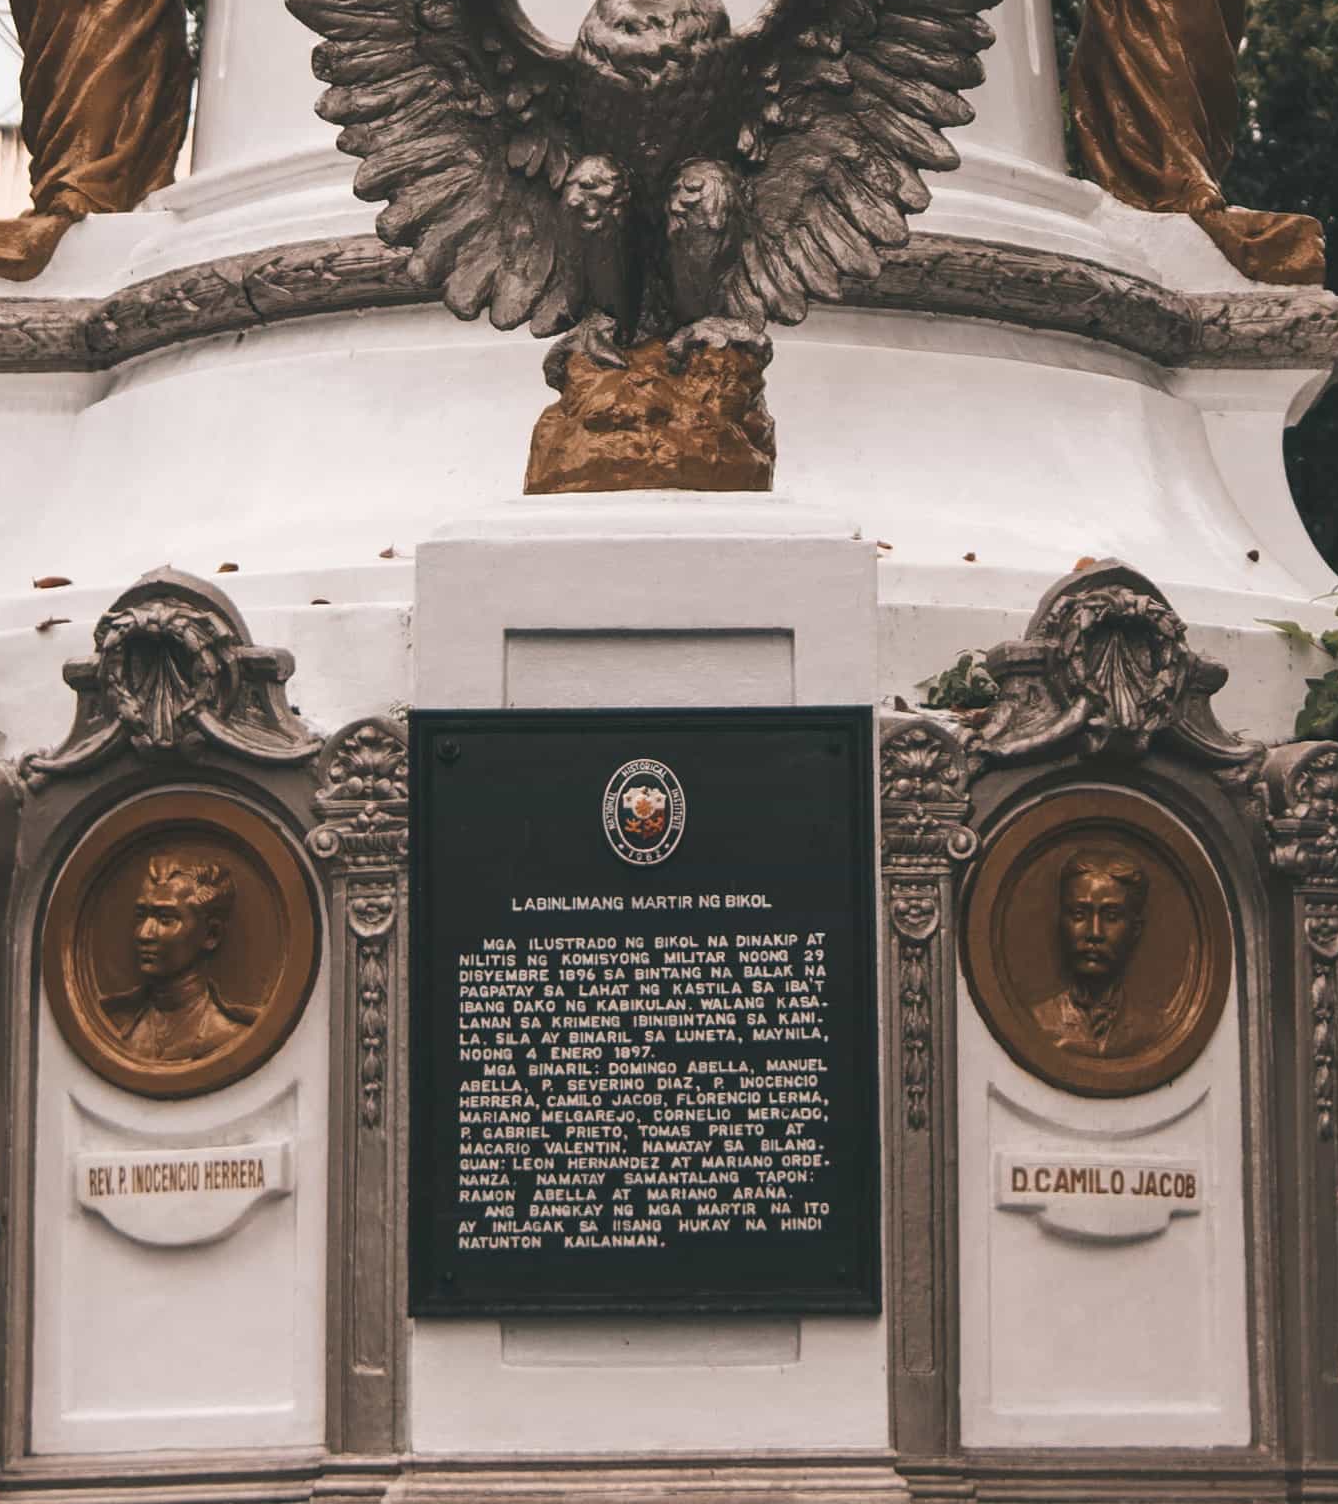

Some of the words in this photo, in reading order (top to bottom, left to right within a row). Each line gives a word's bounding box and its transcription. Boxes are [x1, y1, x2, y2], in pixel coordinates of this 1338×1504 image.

[621, 761, 667, 778] HISTORICAL
[511, 895, 624, 912] LABINLIMANG
[631, 895, 693, 910] MARTIR
[698, 894, 721, 909] NG
[724, 894, 773, 909] BIKOL
[483, 938, 517, 951] MGA
[528, 936, 617, 951] ILUSTRADO
[625, 936, 645, 949] NG
[654, 935, 699, 950] BIKOL
[707, 935, 729, 948] NA
[735, 933, 798, 948] DINAKIP
[806, 932, 826, 946] AT
[459, 953, 517, 968] NILITIS
[526, 954, 548, 967] NG
[561, 951, 650, 966] KOMISYONG
[663, 951, 726, 965] MILITAR
[738, 949, 789, 963] NOONG
[803, 948, 825, 962] 29
[558, 967, 596, 982] 1896
[603, 967, 626, 981] SA
[634, 966, 702, 981] BINTANG
[710, 966, 734, 979] NA
[743, 964, 794, 979] BALAK
[804, 964, 827, 977] NA
[459, 984, 535, 999] PAGPATAY
[543, 984, 565, 998] SA
[578, 983, 630, 997] LAHAT
[639, 983, 661, 996] NG
[672, 981, 743, 996] KASTILA
[751, 980, 775, 994] SA
[785, 976, 825, 993] IBA'T
[459, 1000, 505, 1014] IBANG
[513, 999, 556, 1014] DAKO
[565, 999, 587, 1013] NG
[700, 996, 765, 1011] WALANG
[459, 1015, 512, 1030] LANAN
[520, 1016, 542, 1030] SA
[551, 1015, 621, 1029] KRIMENG
[633, 1012, 737, 1028] IBINIBINTANG
[746, 1012, 768, 1026] SA
[495, 1032, 531, 1046] SILA
[540, 1031, 560, 1044] AY
[568, 1030, 633, 1045] BINARIL
[644, 1029, 666, 1043] SA
[459, 1047, 513, 1062] NOONG
[525, 1047, 538, 1060] 4
[550, 1046, 603, 1061] ENERO
[483, 1063, 517, 1077] MGA
[608, 1061, 677, 1076] DOMINGO
[766, 1058, 828, 1072] MANUEL
[566, 1077, 645, 1092] SEVERINO
[739, 1074, 819, 1089] INOCENCIO
[546, 1093, 602, 1108] CAMILO
[676, 1091, 761, 1106] FLORENCIO
[458, 1110, 531, 1124] MARIANO
[653, 1107, 731, 1123] CORNELIO
[482, 1125, 551, 1140] GABRIEL
[637, 1124, 691, 1138] TOMAS
[708, 1123, 765, 1137] PRIETO
[785, 1122, 806, 1136] AT
[459, 1142, 531, 1156] MACARIO
[642, 1140, 713, 1154] NAMATAY
[723, 1139, 745, 1153] SA
[512, 1157, 555, 1171] LEON
[567, 1156, 660, 1170] HERNANDEZ
[670, 1156, 692, 1169] AT
[701, 1155, 774, 1169] MARIANO
[89, 1166, 115, 1196] REV.
[118, 1165, 128, 1194] P.
[131, 1161, 200, 1194] INOCENCIO
[204, 1158, 265, 1190] HERRERA
[536, 1172, 606, 1186] NAMATAY
[623, 1170, 740, 1186] SAMANTALANG
[1130, 1170, 1197, 1199] JACOB
[458, 1189, 516, 1203] RAMON
[532, 1188, 597, 1202] ABELLA
[612, 1188, 632, 1201] AT
[646, 1187, 718, 1201] MARIANO
[484, 1204, 515, 1219] ANG
[529, 1203, 604, 1218] BANGKAY
[613, 1203, 634, 1217] NG
[648, 1202, 683, 1217] MGA
[697, 1202, 757, 1217] MARTIR
[770, 1202, 792, 1215] NA
[804, 1201, 830, 1215] ITO
[458, 1220, 477, 1235] AY
[492, 1220, 565, 1234] INILAGAK
[579, 1220, 599, 1233] SA
[612, 1218, 662, 1233] IISANG
[678, 1218, 731, 1233] HUKAY
[745, 1218, 767, 1231] NA
[780, 1216, 822, 1231] HINDI
[458, 1235, 542, 1249] NATUNTON
